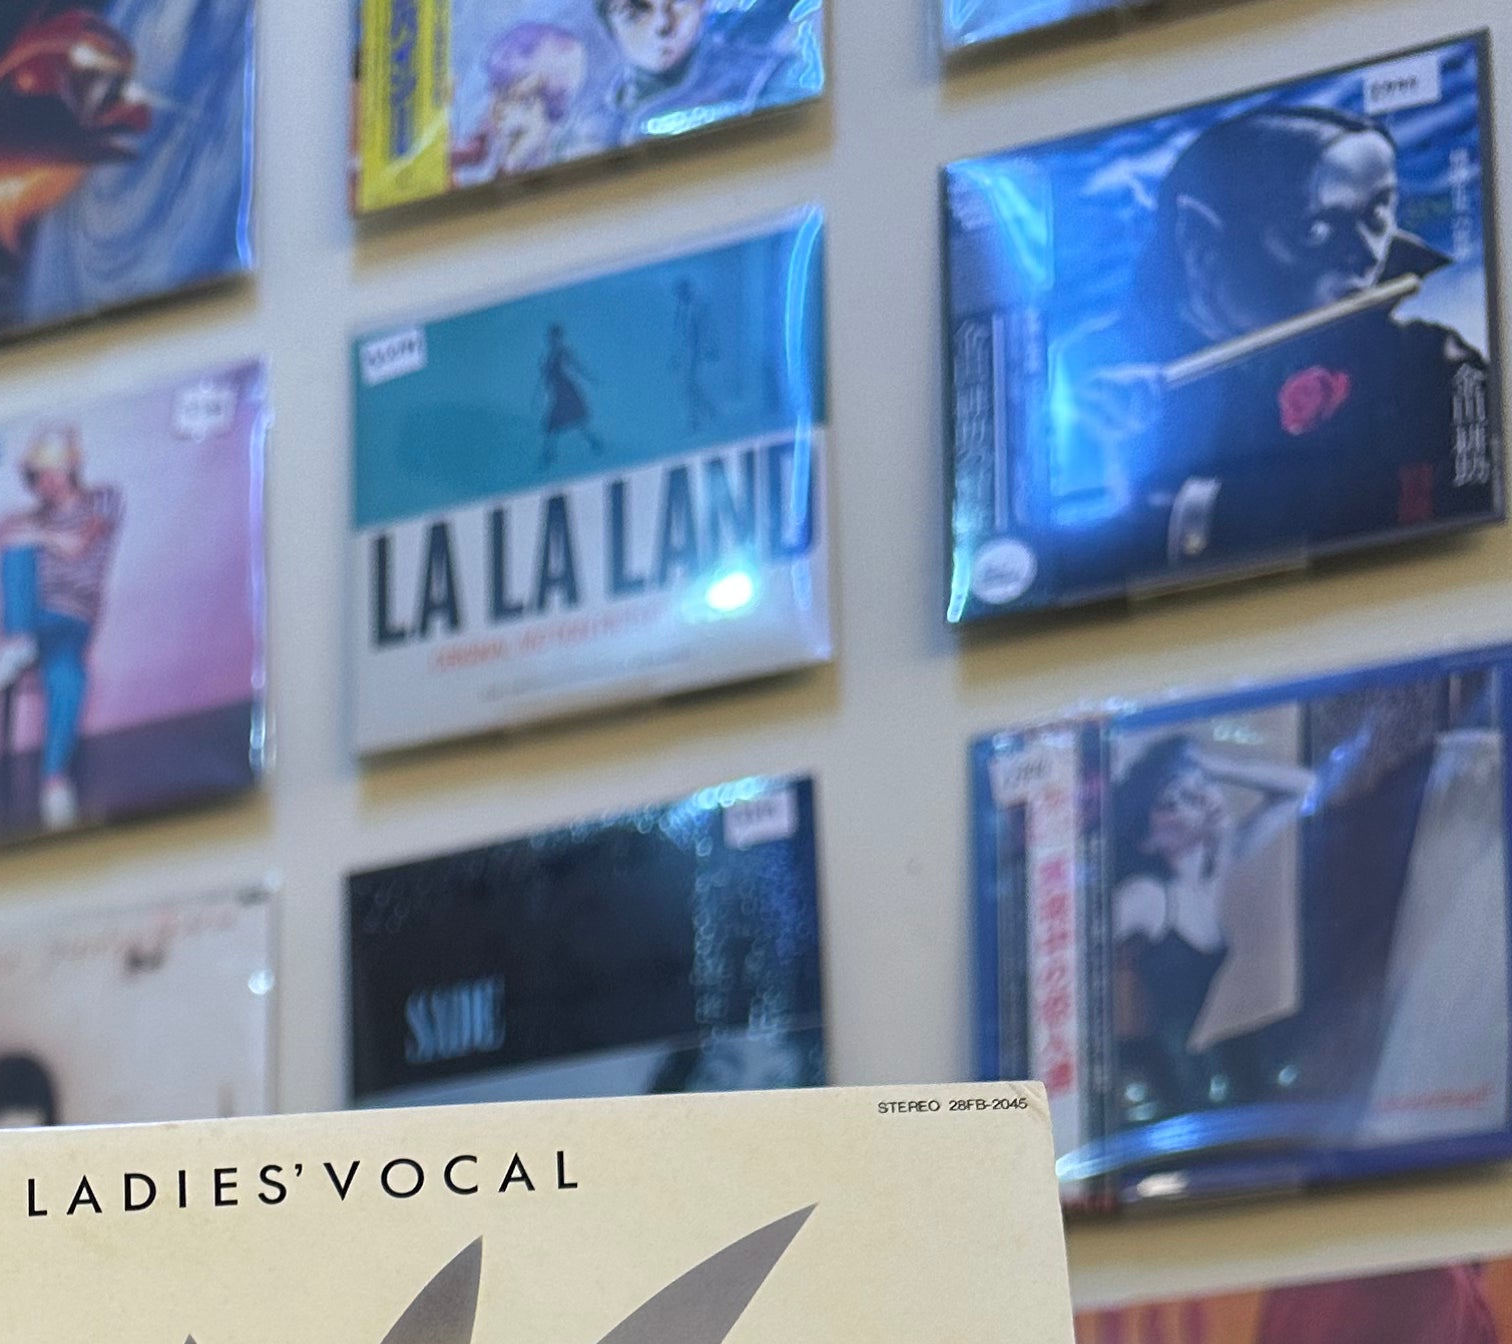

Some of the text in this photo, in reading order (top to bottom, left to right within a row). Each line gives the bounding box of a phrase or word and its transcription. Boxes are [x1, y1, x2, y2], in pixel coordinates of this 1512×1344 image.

[371, 520, 461, 650] LA
[488, 493, 581, 623] LA
[606, 440, 814, 598] LAND
[877, 1097, 1029, 1114] STEREO 28FB-2045
